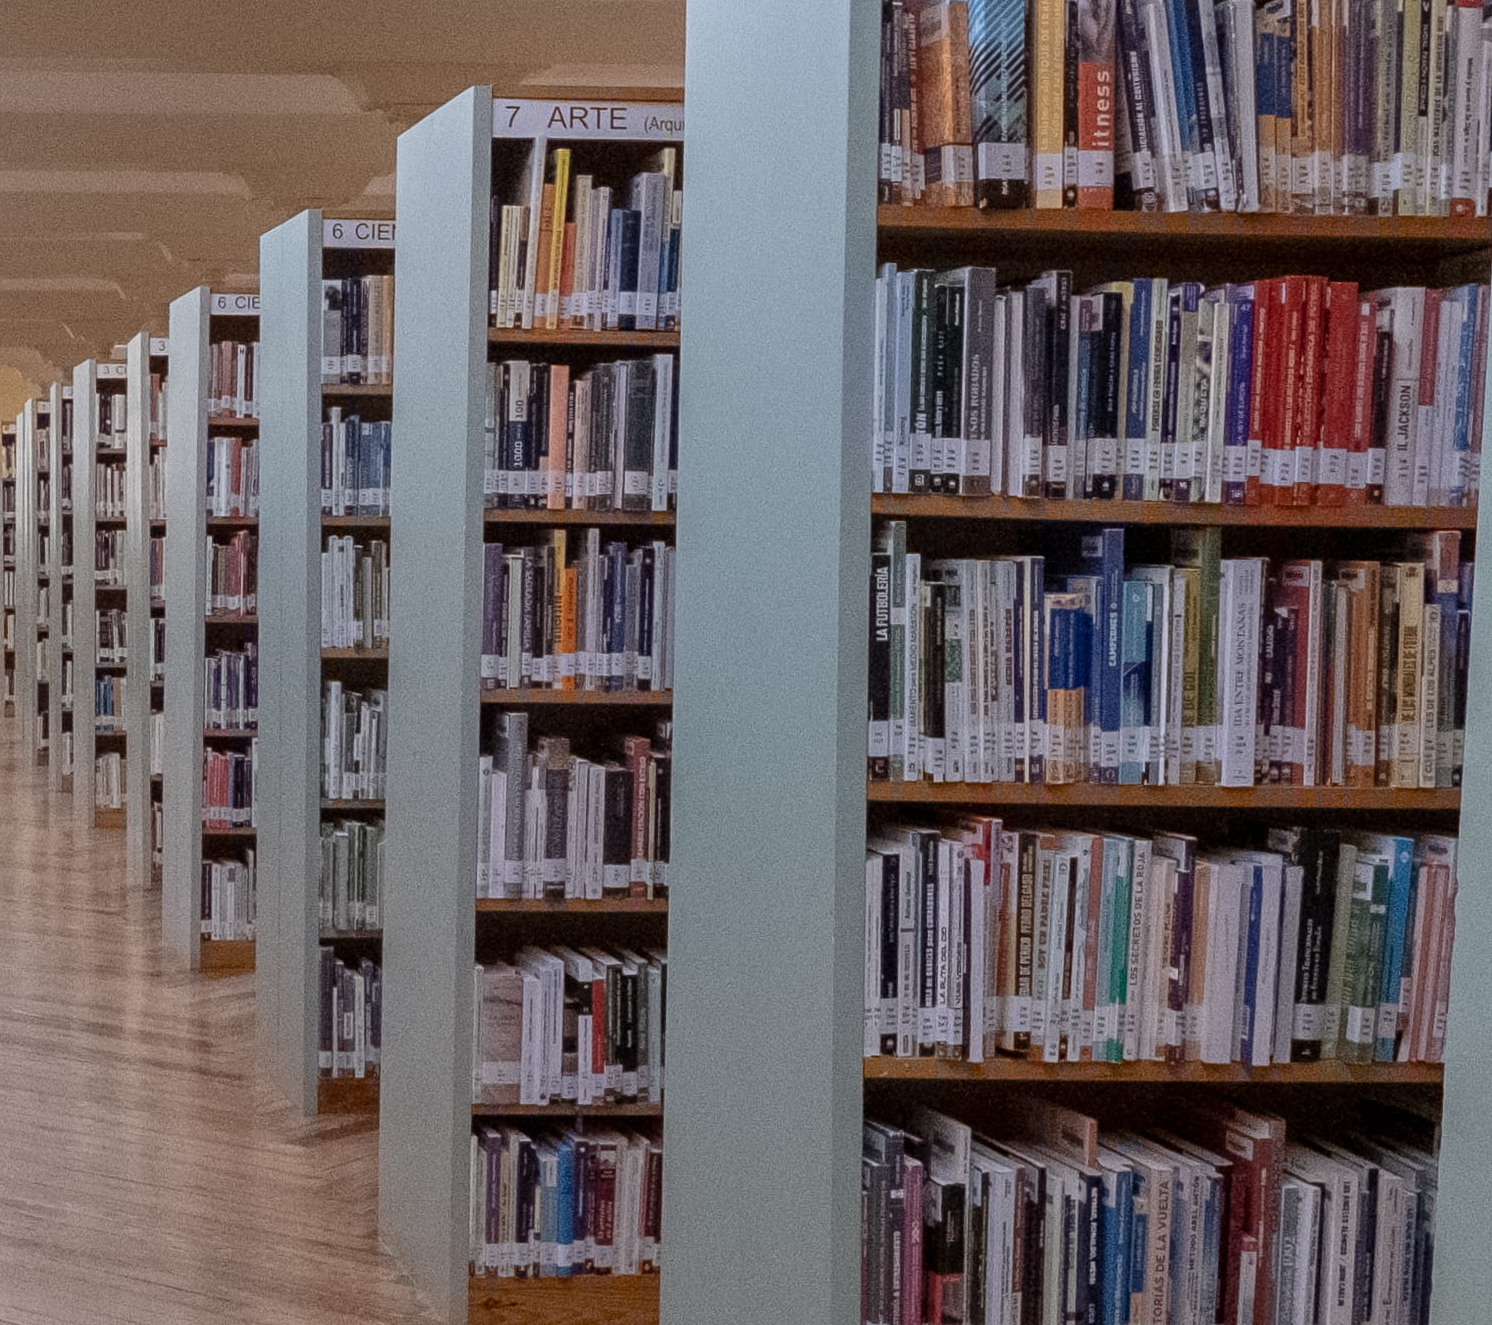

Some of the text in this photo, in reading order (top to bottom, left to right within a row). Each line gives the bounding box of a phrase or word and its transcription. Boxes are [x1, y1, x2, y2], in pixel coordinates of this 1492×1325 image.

[1092, 70, 1111, 147] itness
[505, 105, 521, 128] 7
[547, 105, 628, 131] ARTE
[332, 223, 344, 240] 6
[217, 295, 227, 309] 6
[158, 340, 166, 352] 3
[1396, 385, 1411, 440] JACKSON
[876, 626, 888, 642] LA
[1158, 1180, 1170, 1230] VUELTA
[1156, 1233, 1168, 1251] LA
[1154, 1255, 1167, 1273] DE
